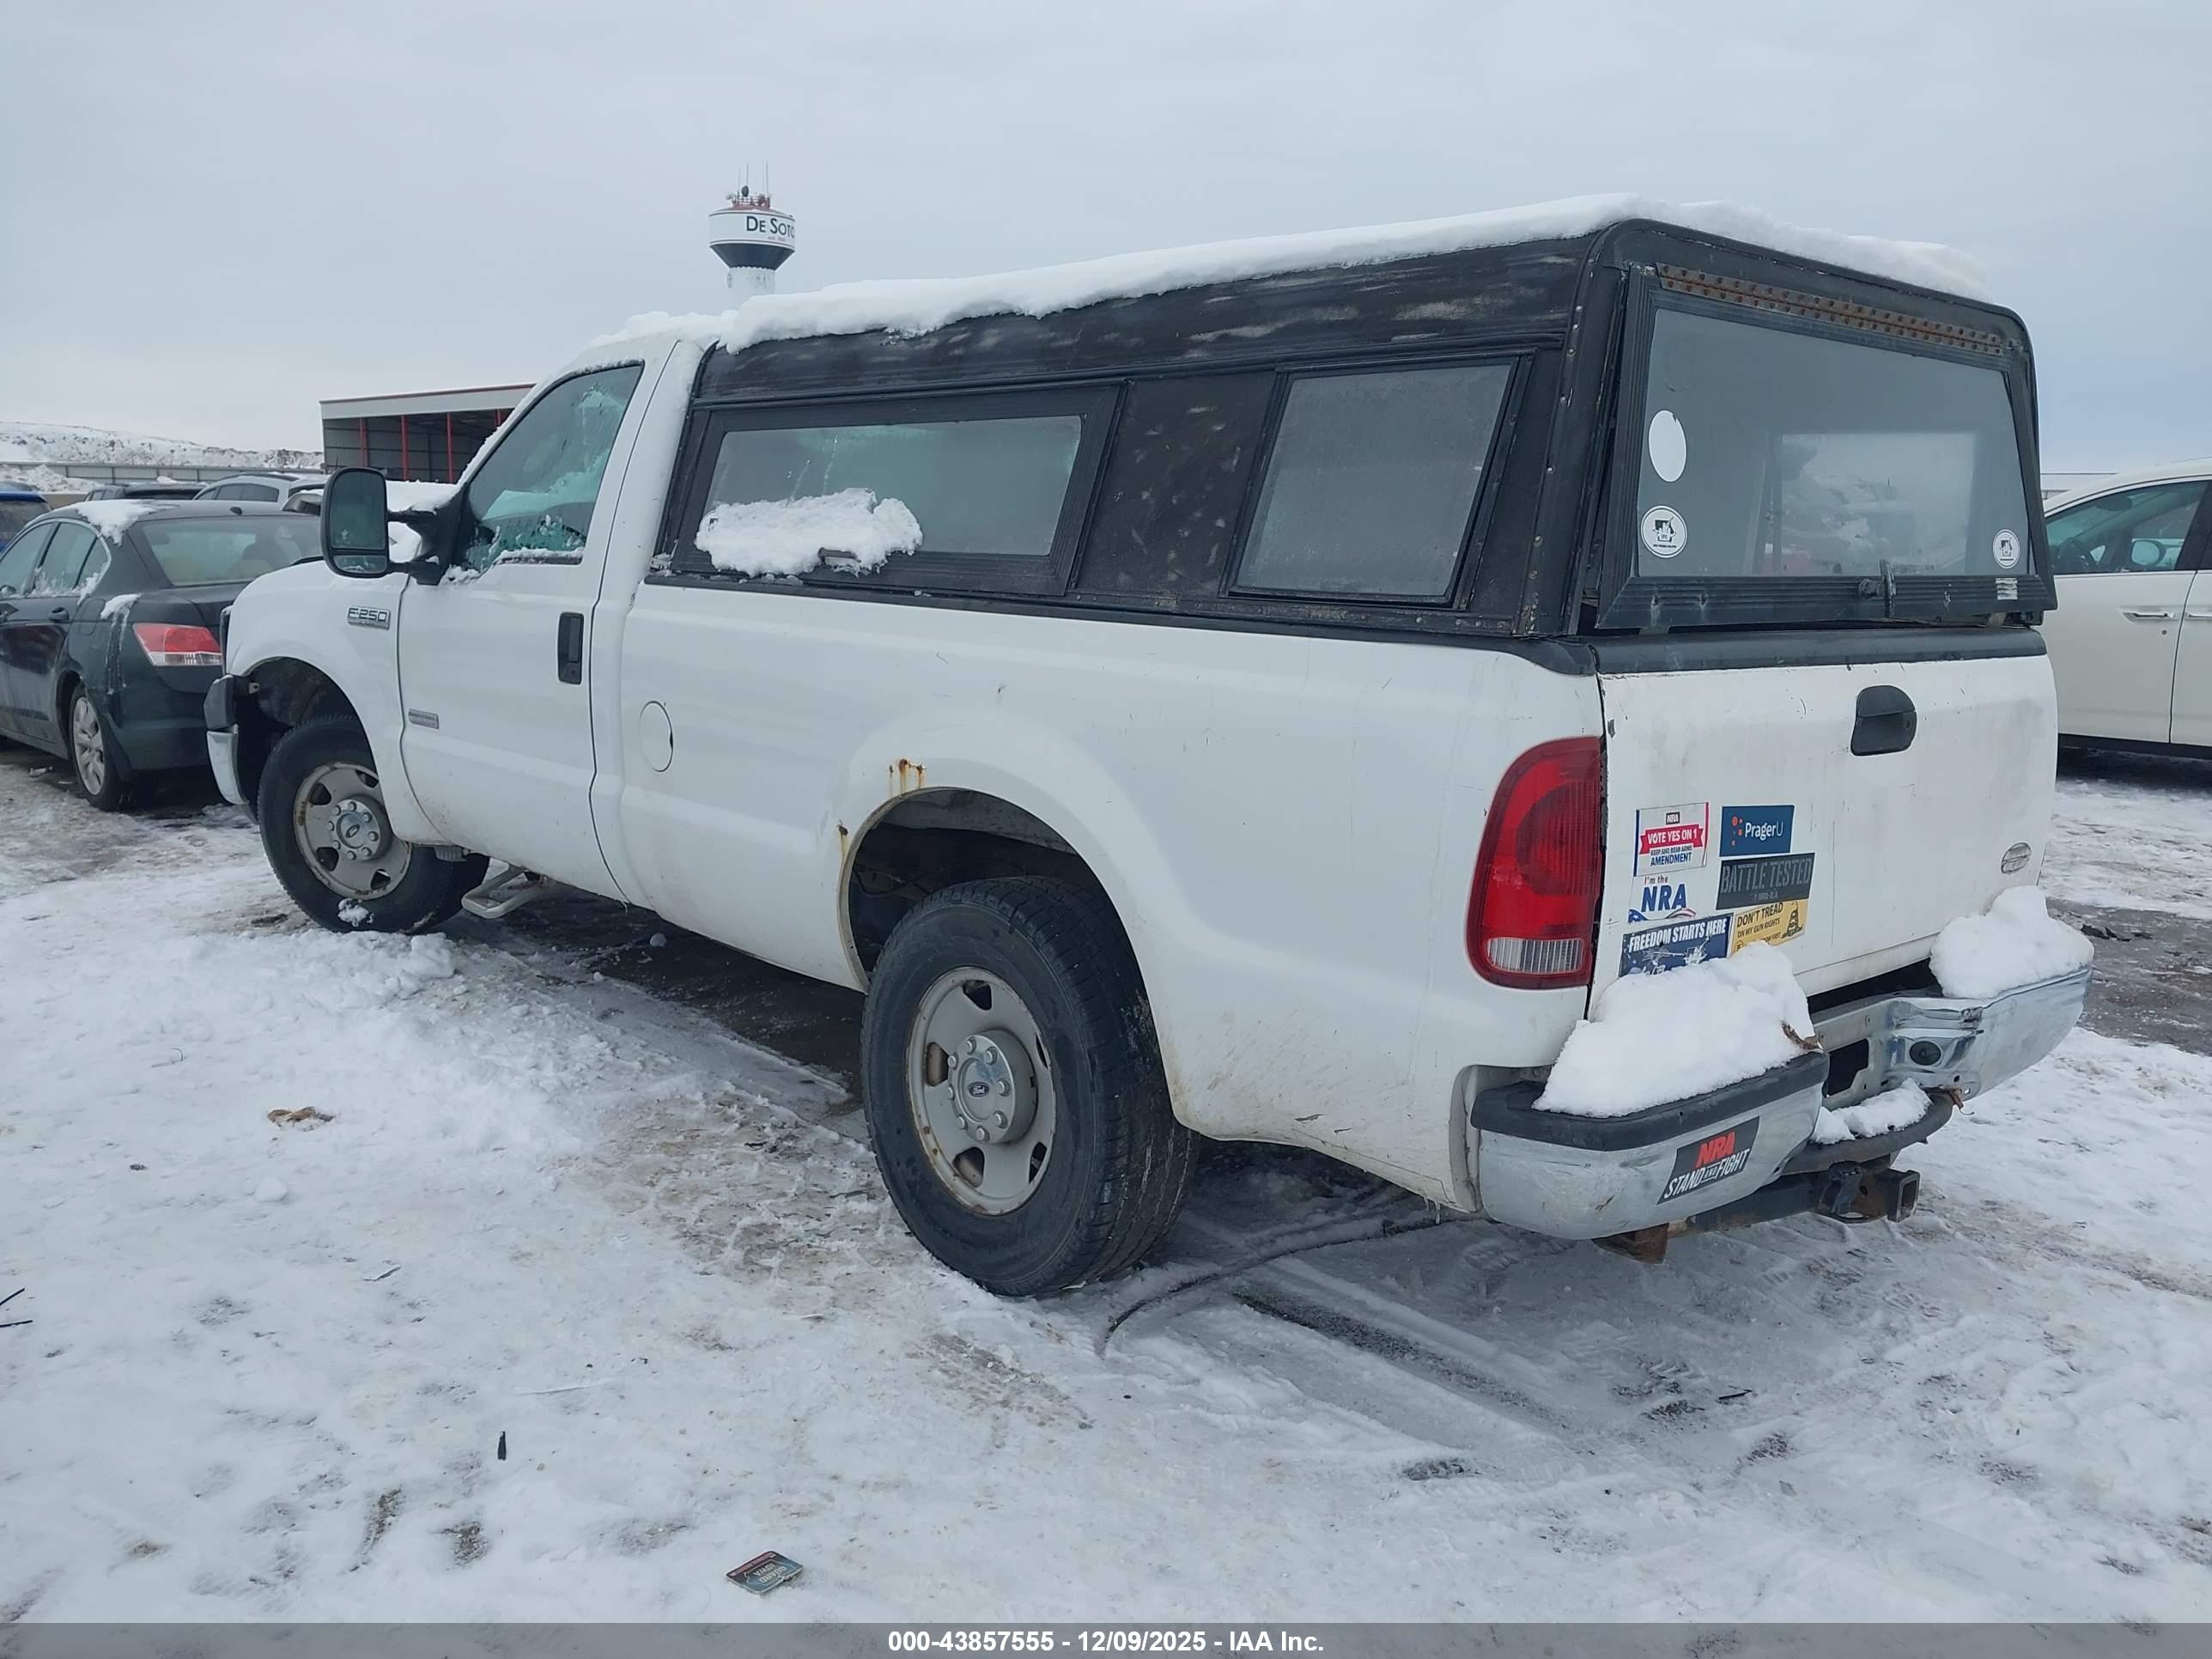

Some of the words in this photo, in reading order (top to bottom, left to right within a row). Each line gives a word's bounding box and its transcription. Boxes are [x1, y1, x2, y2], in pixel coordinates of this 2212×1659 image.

[347, 607, 388, 622] F-250
[1647, 831, 1667, 845] VOTE
[1668, 830, 1680, 842] YES
[1681, 829, 1692, 841] ON
[1693, 828, 1698, 840] 1
[1744, 820, 1784, 841] PragerU
[1650, 852, 1692, 867] AMENDMENT
[1644, 876, 1656, 885] I'm
[1657, 874, 1668, 884] the
[1720, 862, 1767, 893] BATTLE
[1769, 859, 1812, 889] TESTED
[1641, 884, 1686, 912] NRA
[1736, 910, 1760, 928] DON'T
[1761, 902, 1784, 919] TREAD
[1628, 927, 1672, 953] FREEDOM
[1672, 921, 1706, 943] STARTS
[1705, 918, 1728, 937] HERE
[1737, 929, 1745, 939] ON
[1745, 926, 1753, 936] MY
[1753, 922, 1764, 933] GUN
[1764, 917, 1781, 929] RIGHTS
[1694, 1131, 1735, 1169] NRA
[1663, 1168, 1706, 1199] STAND
[1715, 1148, 1751, 1180] FIGHT
